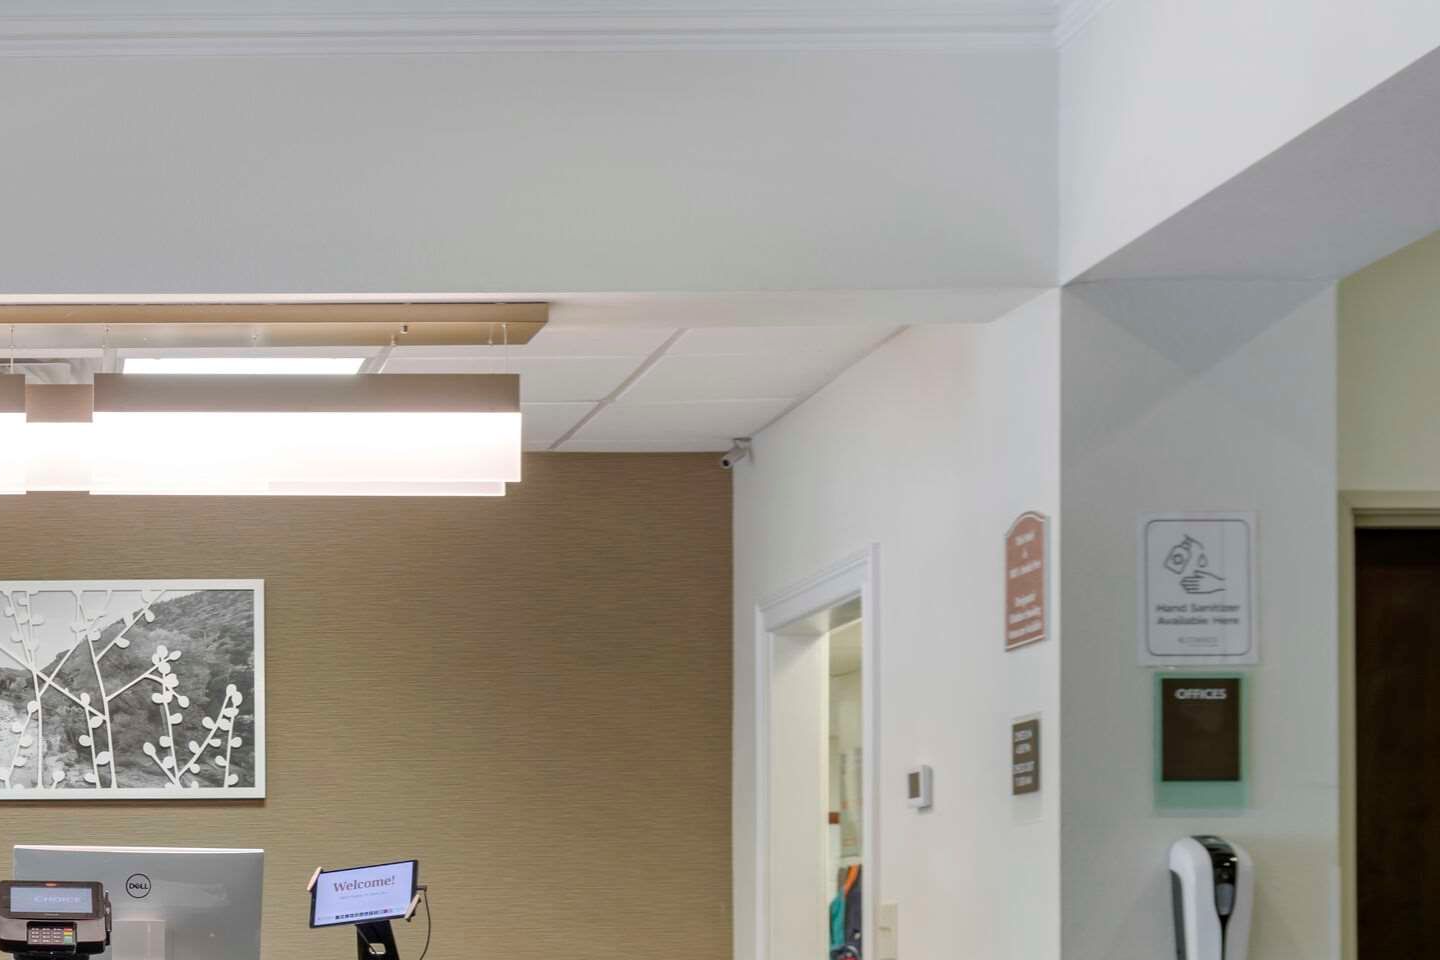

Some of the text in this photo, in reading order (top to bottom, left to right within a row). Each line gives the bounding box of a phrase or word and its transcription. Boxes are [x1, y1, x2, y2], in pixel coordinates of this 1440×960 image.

[1156, 603, 1241, 613] Hand Sanitizer
[1157, 616, 1239, 625] Available Here
[1174, 687, 1227, 700] OFFICES
[129, 882, 149, 890] DELL
[333, 875, 396, 892] Welcome!
[33, 895, 81, 904] CHOICE
